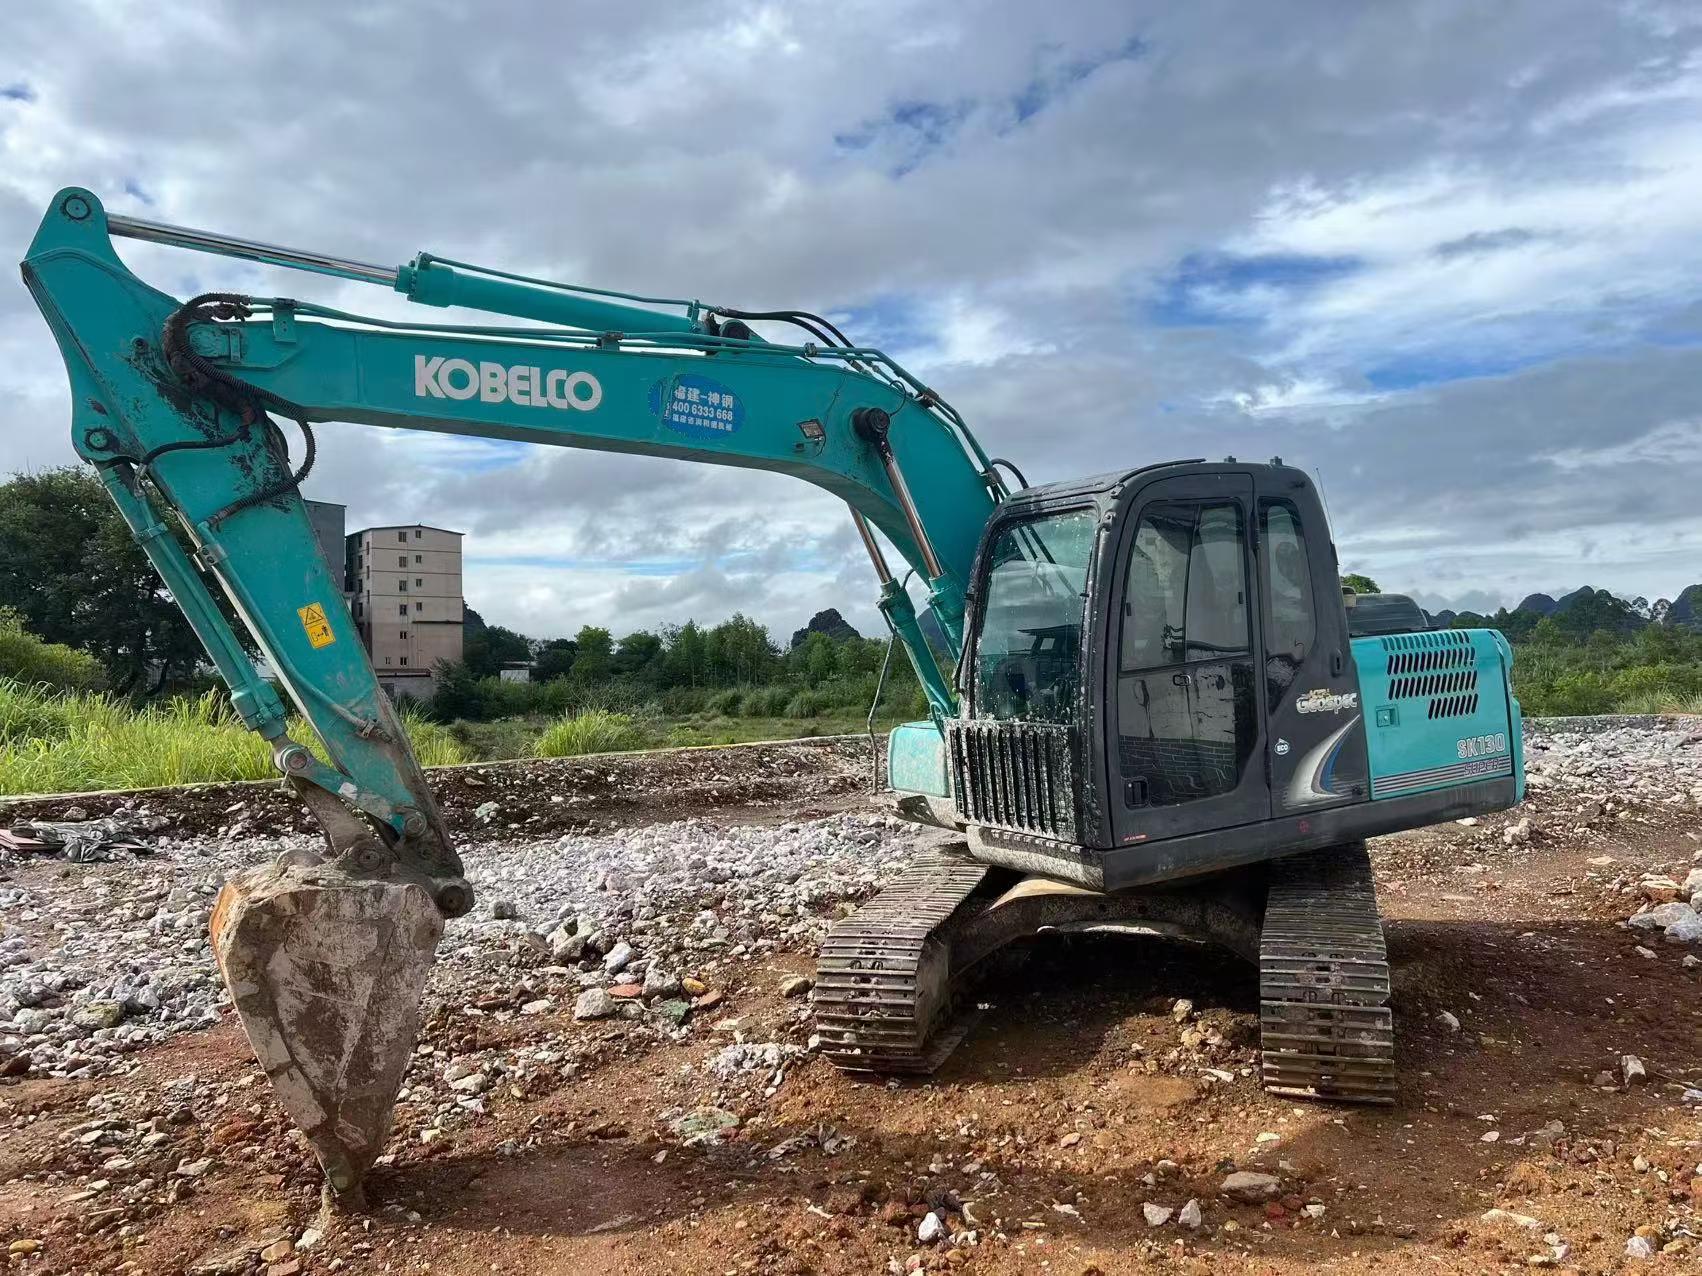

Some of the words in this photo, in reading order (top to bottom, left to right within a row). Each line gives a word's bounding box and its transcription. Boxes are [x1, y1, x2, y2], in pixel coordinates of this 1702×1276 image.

[415, 354, 602, 411] KOBELCO
[672, 401, 690, 413] 400
[692, 405, 715, 418] 6333
[716, 409, 733, 421] 668
[1276, 744, 1289, 752] ECO
[1457, 733, 1506, 759] SK130
[1464, 759, 1500, 776] SUPER
